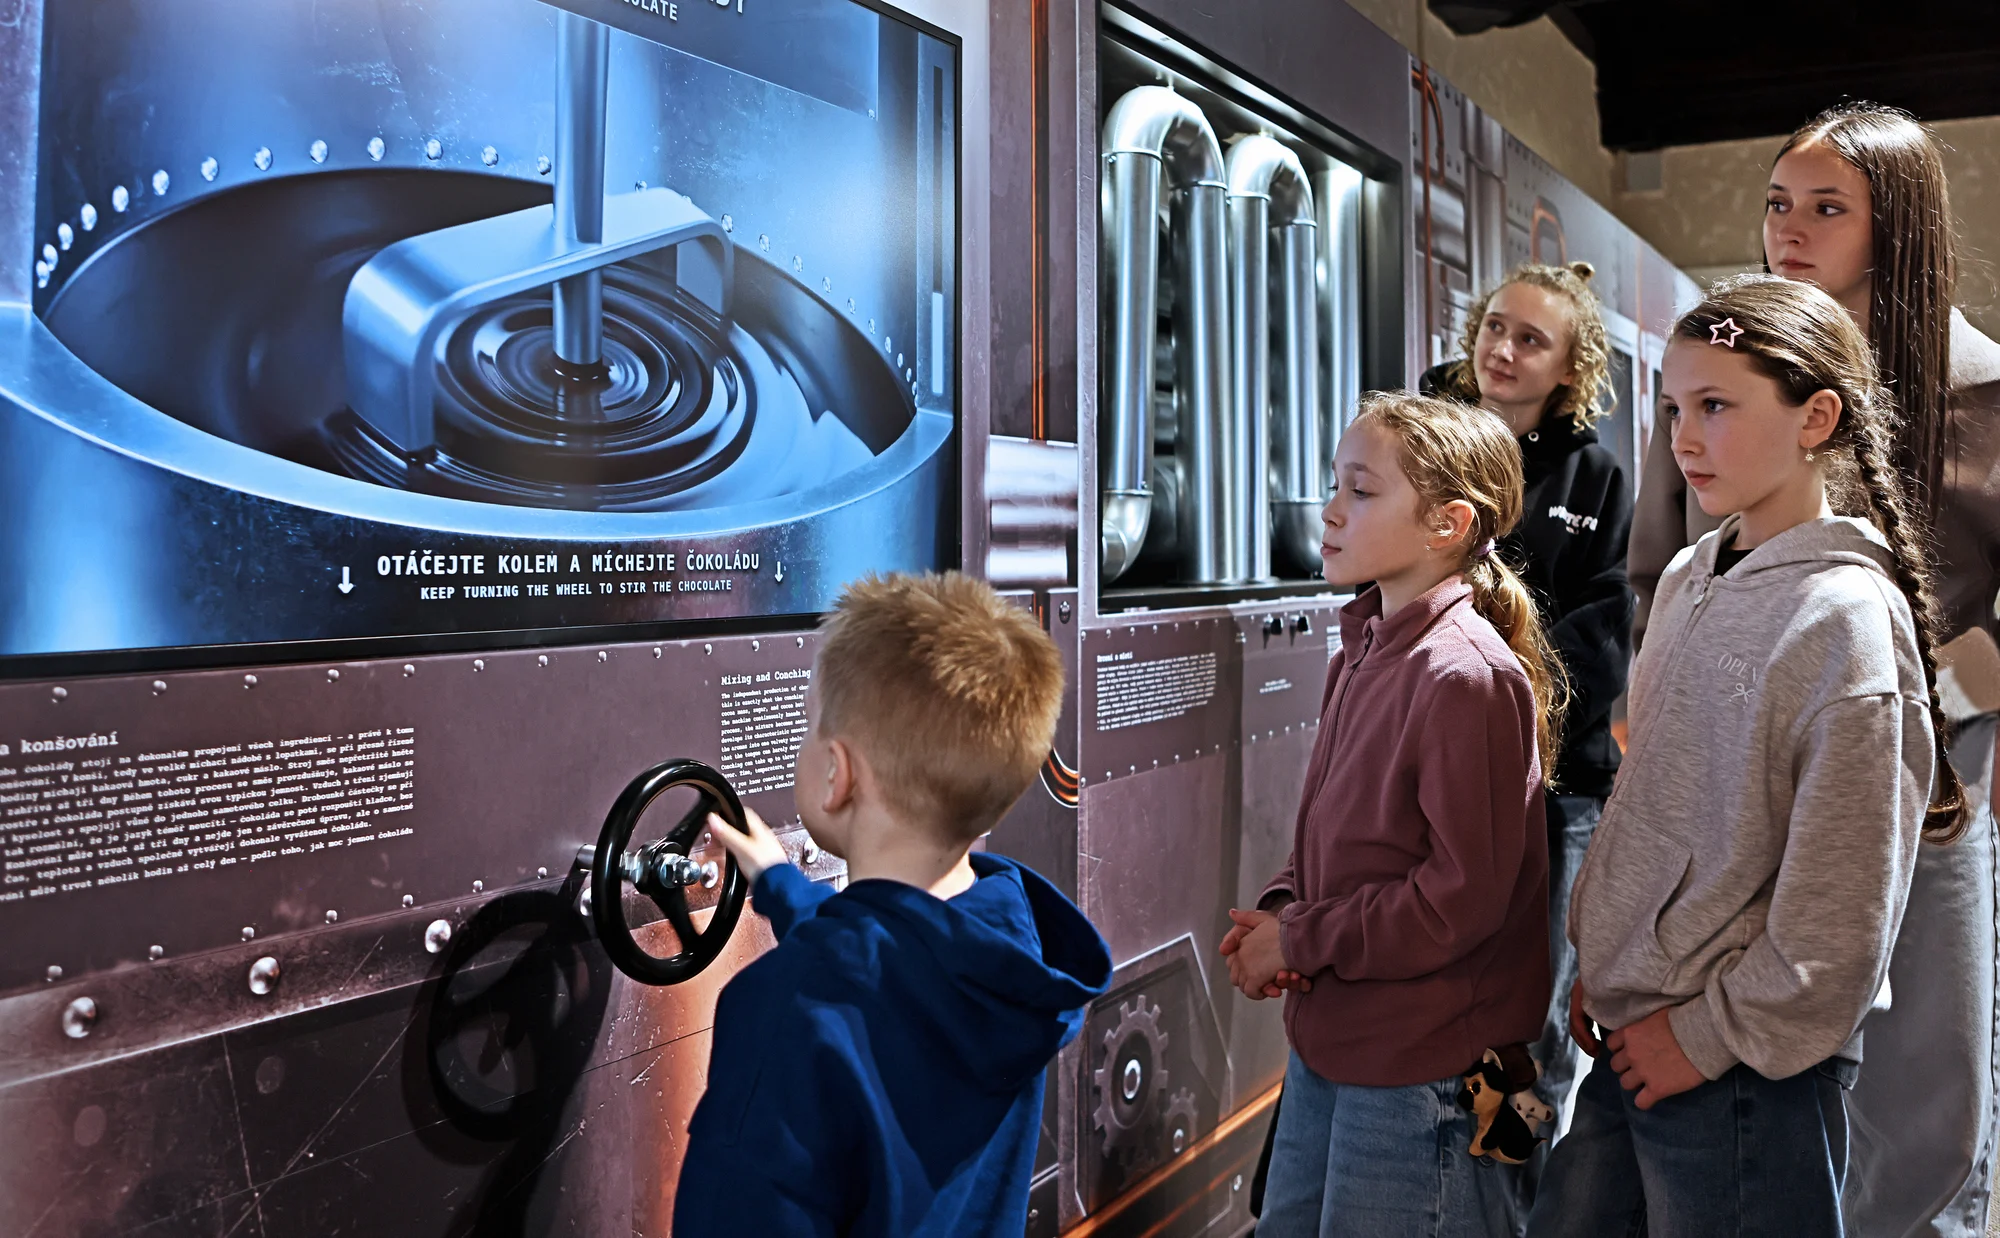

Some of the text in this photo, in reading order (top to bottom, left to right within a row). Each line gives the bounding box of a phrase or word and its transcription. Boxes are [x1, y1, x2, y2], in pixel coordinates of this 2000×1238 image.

[624, 0, 678, 21] LATE
[377, 548, 760, 577] OTÁČEJTE KOLEM A MÍCHEJTE ČOKOLÁDU
[420, 580, 732, 600] KEEP TURNING THE WHEEL TO STIR THE CHOCOLATE
[720, 668, 811, 685] Mixing and Conching
[21, 731, 118, 753] konšování
